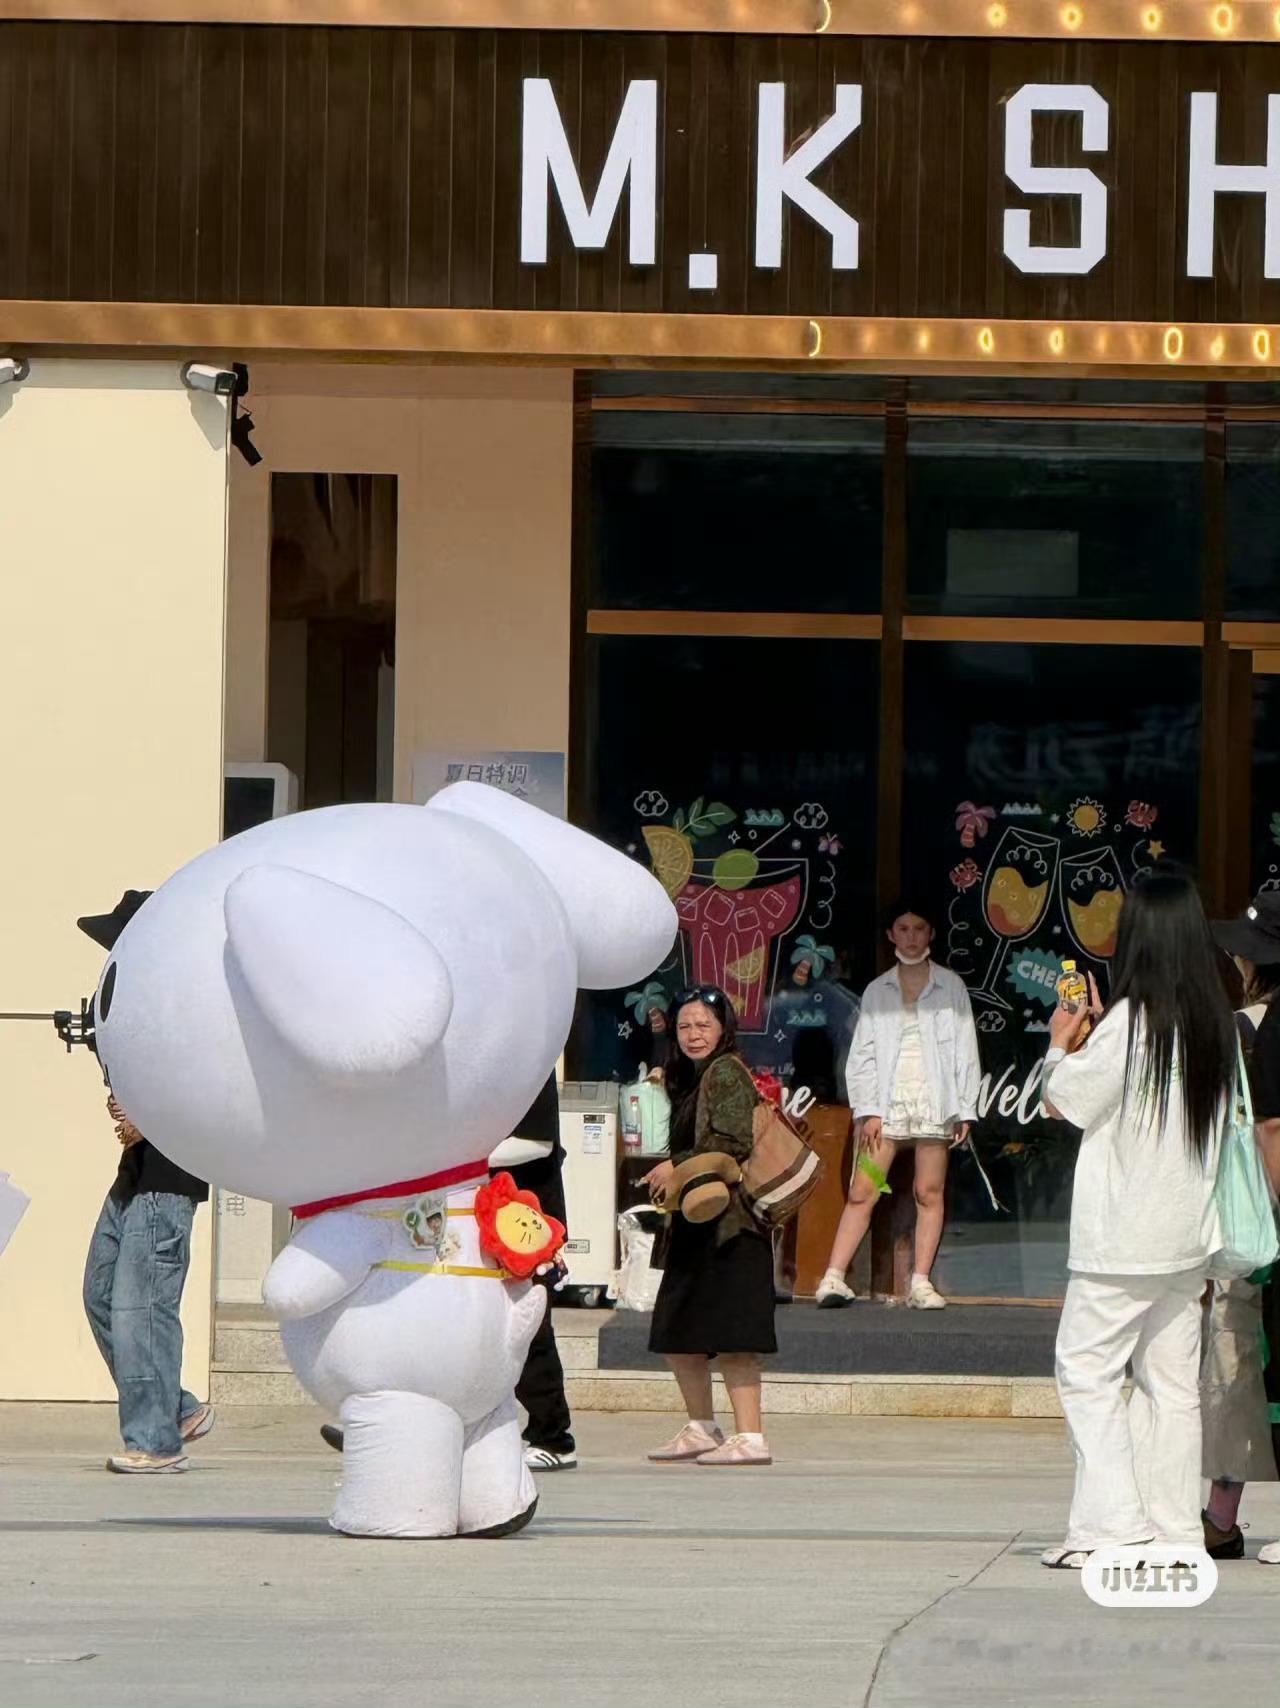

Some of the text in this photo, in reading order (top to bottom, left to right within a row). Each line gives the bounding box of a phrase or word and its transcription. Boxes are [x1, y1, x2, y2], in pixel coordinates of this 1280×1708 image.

[447, 763, 528, 784] 夏日特调
[1017, 960, 1057, 991] CHE
